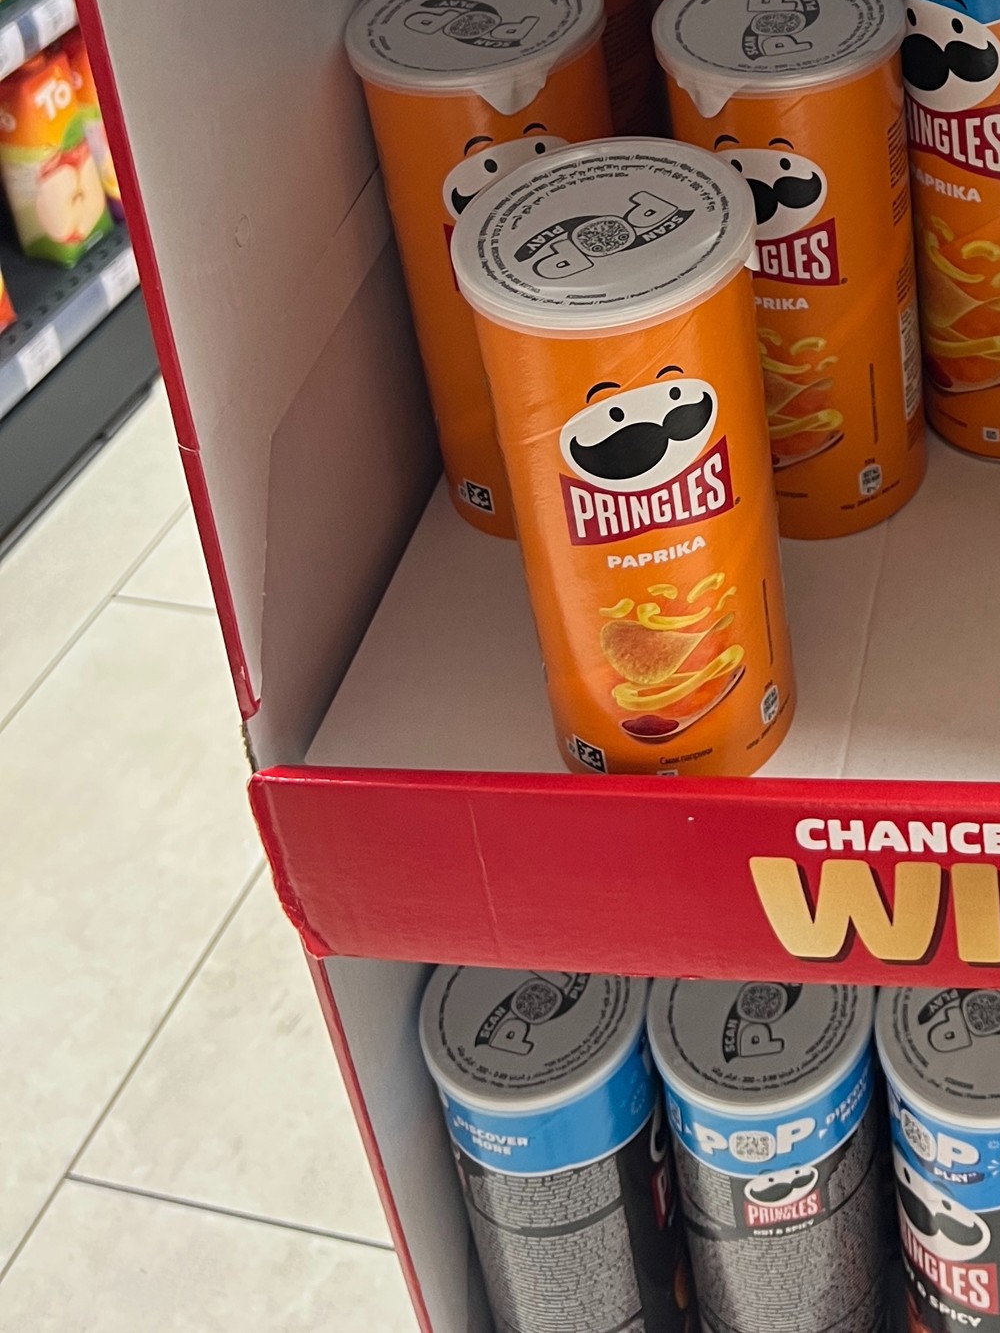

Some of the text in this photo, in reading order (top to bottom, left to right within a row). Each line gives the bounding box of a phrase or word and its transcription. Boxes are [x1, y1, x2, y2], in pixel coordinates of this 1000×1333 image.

[916, 173, 982, 203] APRIKA
[526, 224, 565, 251] PLAY
[641, 215, 684, 243] SCAN
[755, 297, 809, 310] PRIKA
[570, 451, 727, 539] PRINGLES
[607, 535, 707, 569] PAPRIKA
[455, 1115, 530, 1147] DISCOVER
[472, 1137, 513, 1155] MORE
[746, 1193, 820, 1225] PRINGLES
[929, 1294, 982, 1328] SPICY
